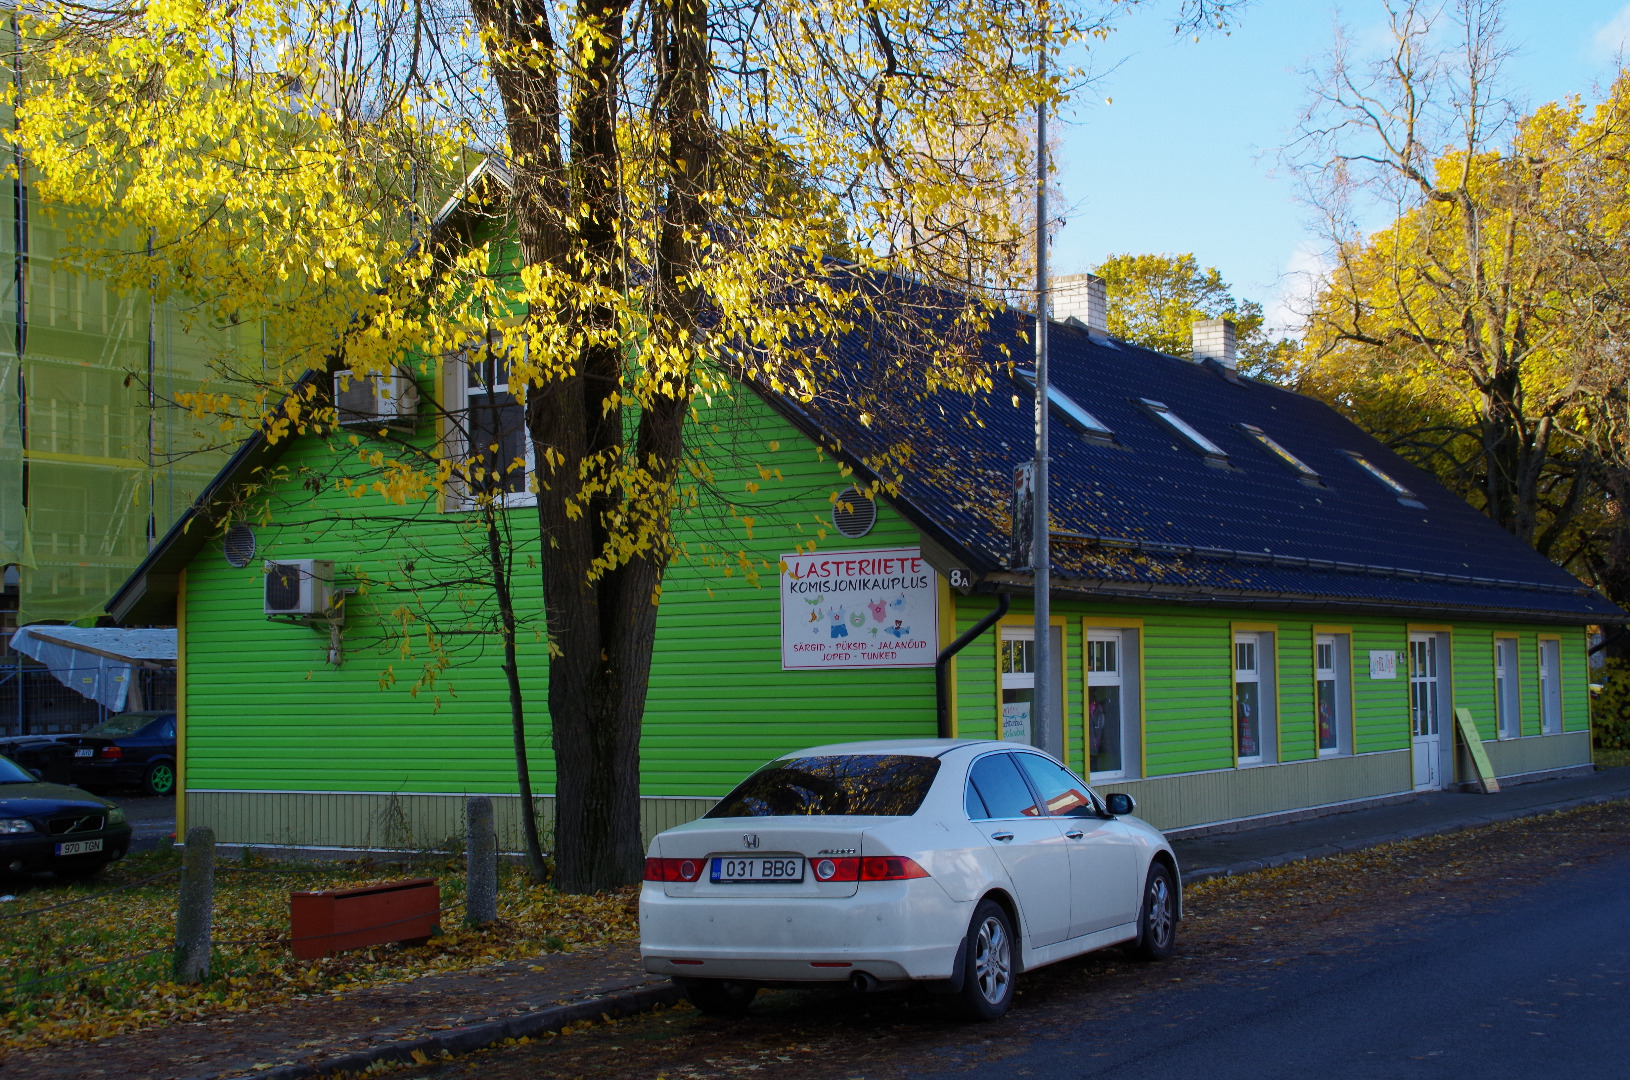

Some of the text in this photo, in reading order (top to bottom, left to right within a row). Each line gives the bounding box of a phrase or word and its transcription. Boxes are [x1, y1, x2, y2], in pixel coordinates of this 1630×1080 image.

[794, 557, 923, 578] LASTERIIETE
[790, 575, 928, 594] KOMISJONIKAUPLUS
[950, 569, 969, 587] 8A
[793, 641, 826, 652] SÄRGID
[835, 640, 867, 651] PÜKSID
[877, 638, 927, 650] JALANÕUD
[821, 652, 851, 662] JOPED
[861, 651, 897, 660] TUNKED
[64, 840, 100, 854] 970 TGN
[726, 860, 796, 877] 031 BBG
